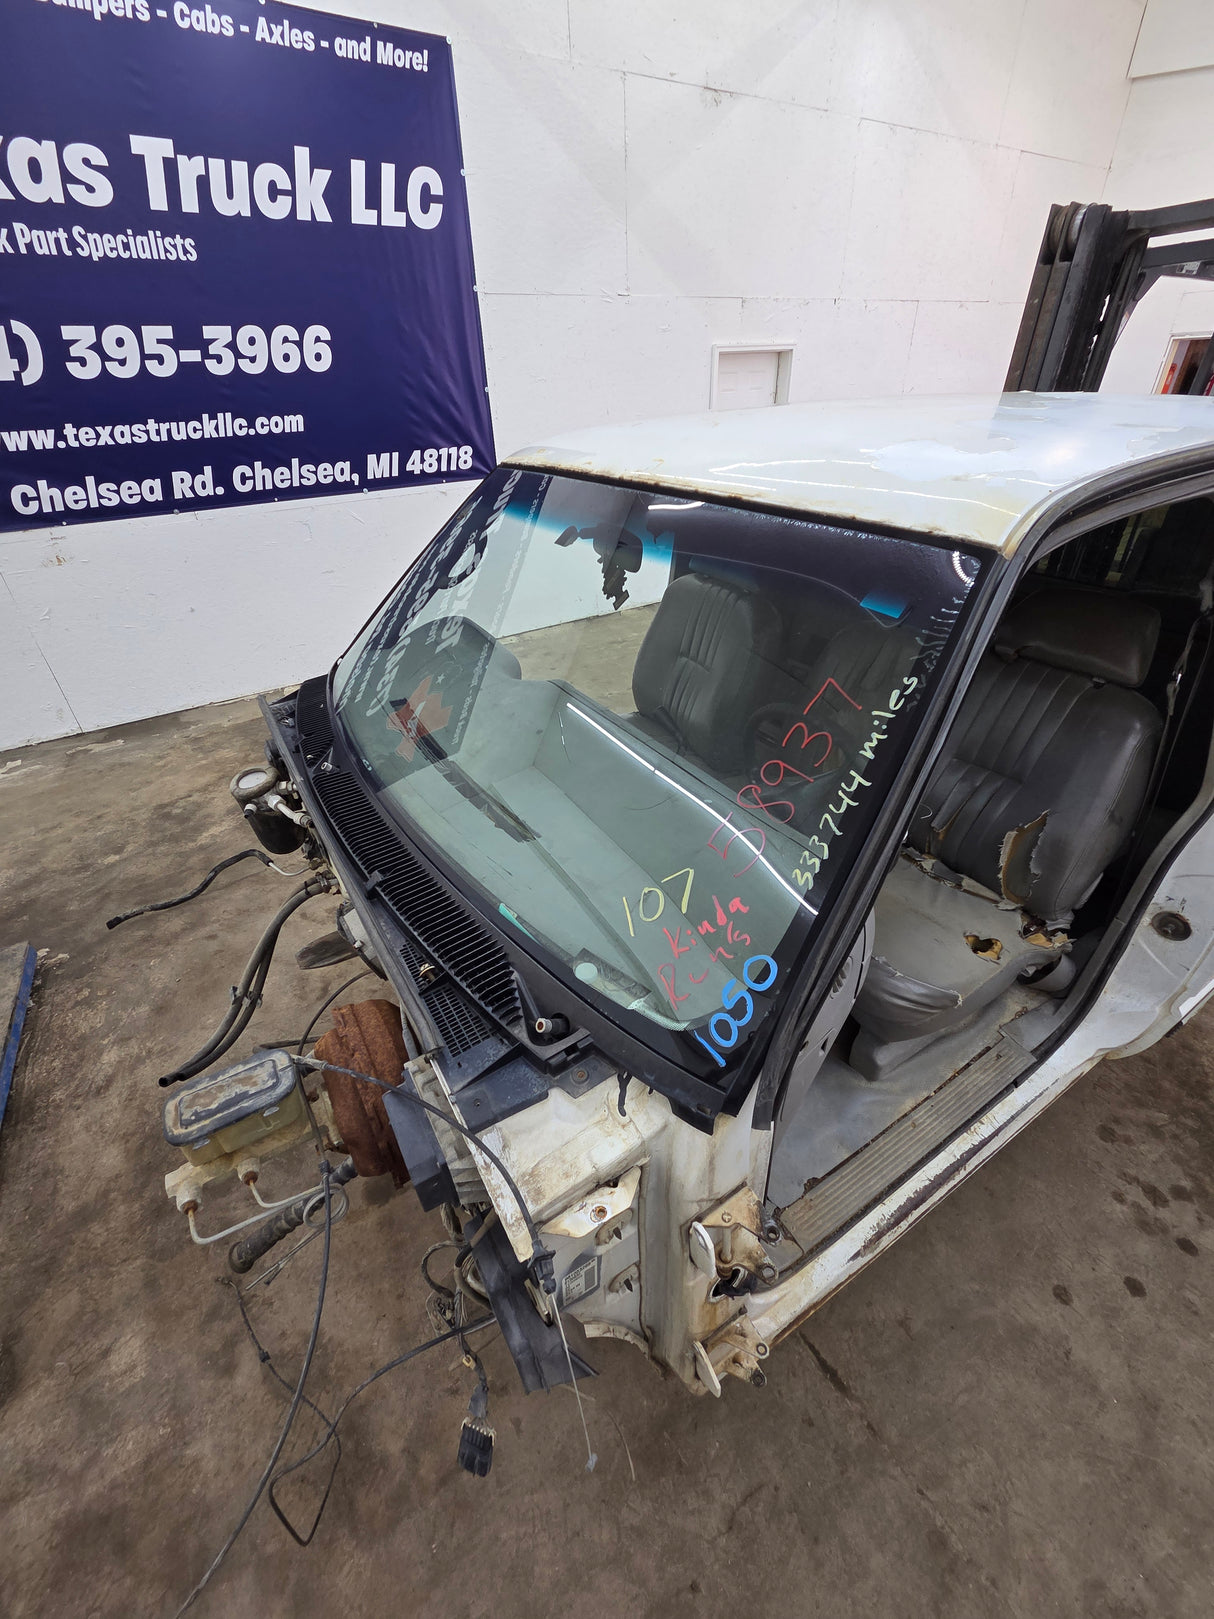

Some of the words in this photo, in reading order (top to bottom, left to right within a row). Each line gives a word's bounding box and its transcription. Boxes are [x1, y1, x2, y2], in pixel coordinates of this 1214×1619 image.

[174, 1, 234, 37] Cabs
[255, 16, 315, 51] Axles
[335, 36, 370, 62] and
[377, 41, 428, 72] More!
[129, 134, 332, 222] Truck
[351, 159, 443, 229] LLC
[12, 222, 72, 256] Part
[72, 225, 197, 261] Specialists
[60, 325, 332, 379] 395-3966
[11, 476, 163, 515] Chelsea
[172, 466, 224, 499] Rd.
[233, 458, 360, 486] Chelsea,
[367, 452, 399, 479] MI
[406, 446, 473, 475] 48118
[859, 676, 918, 760] miles
[707, 677, 862, 879] 58937
[623, 867, 694, 937] 107
[662, 895, 750, 959] Kinda
[694, 954, 778, 1067] 1050
